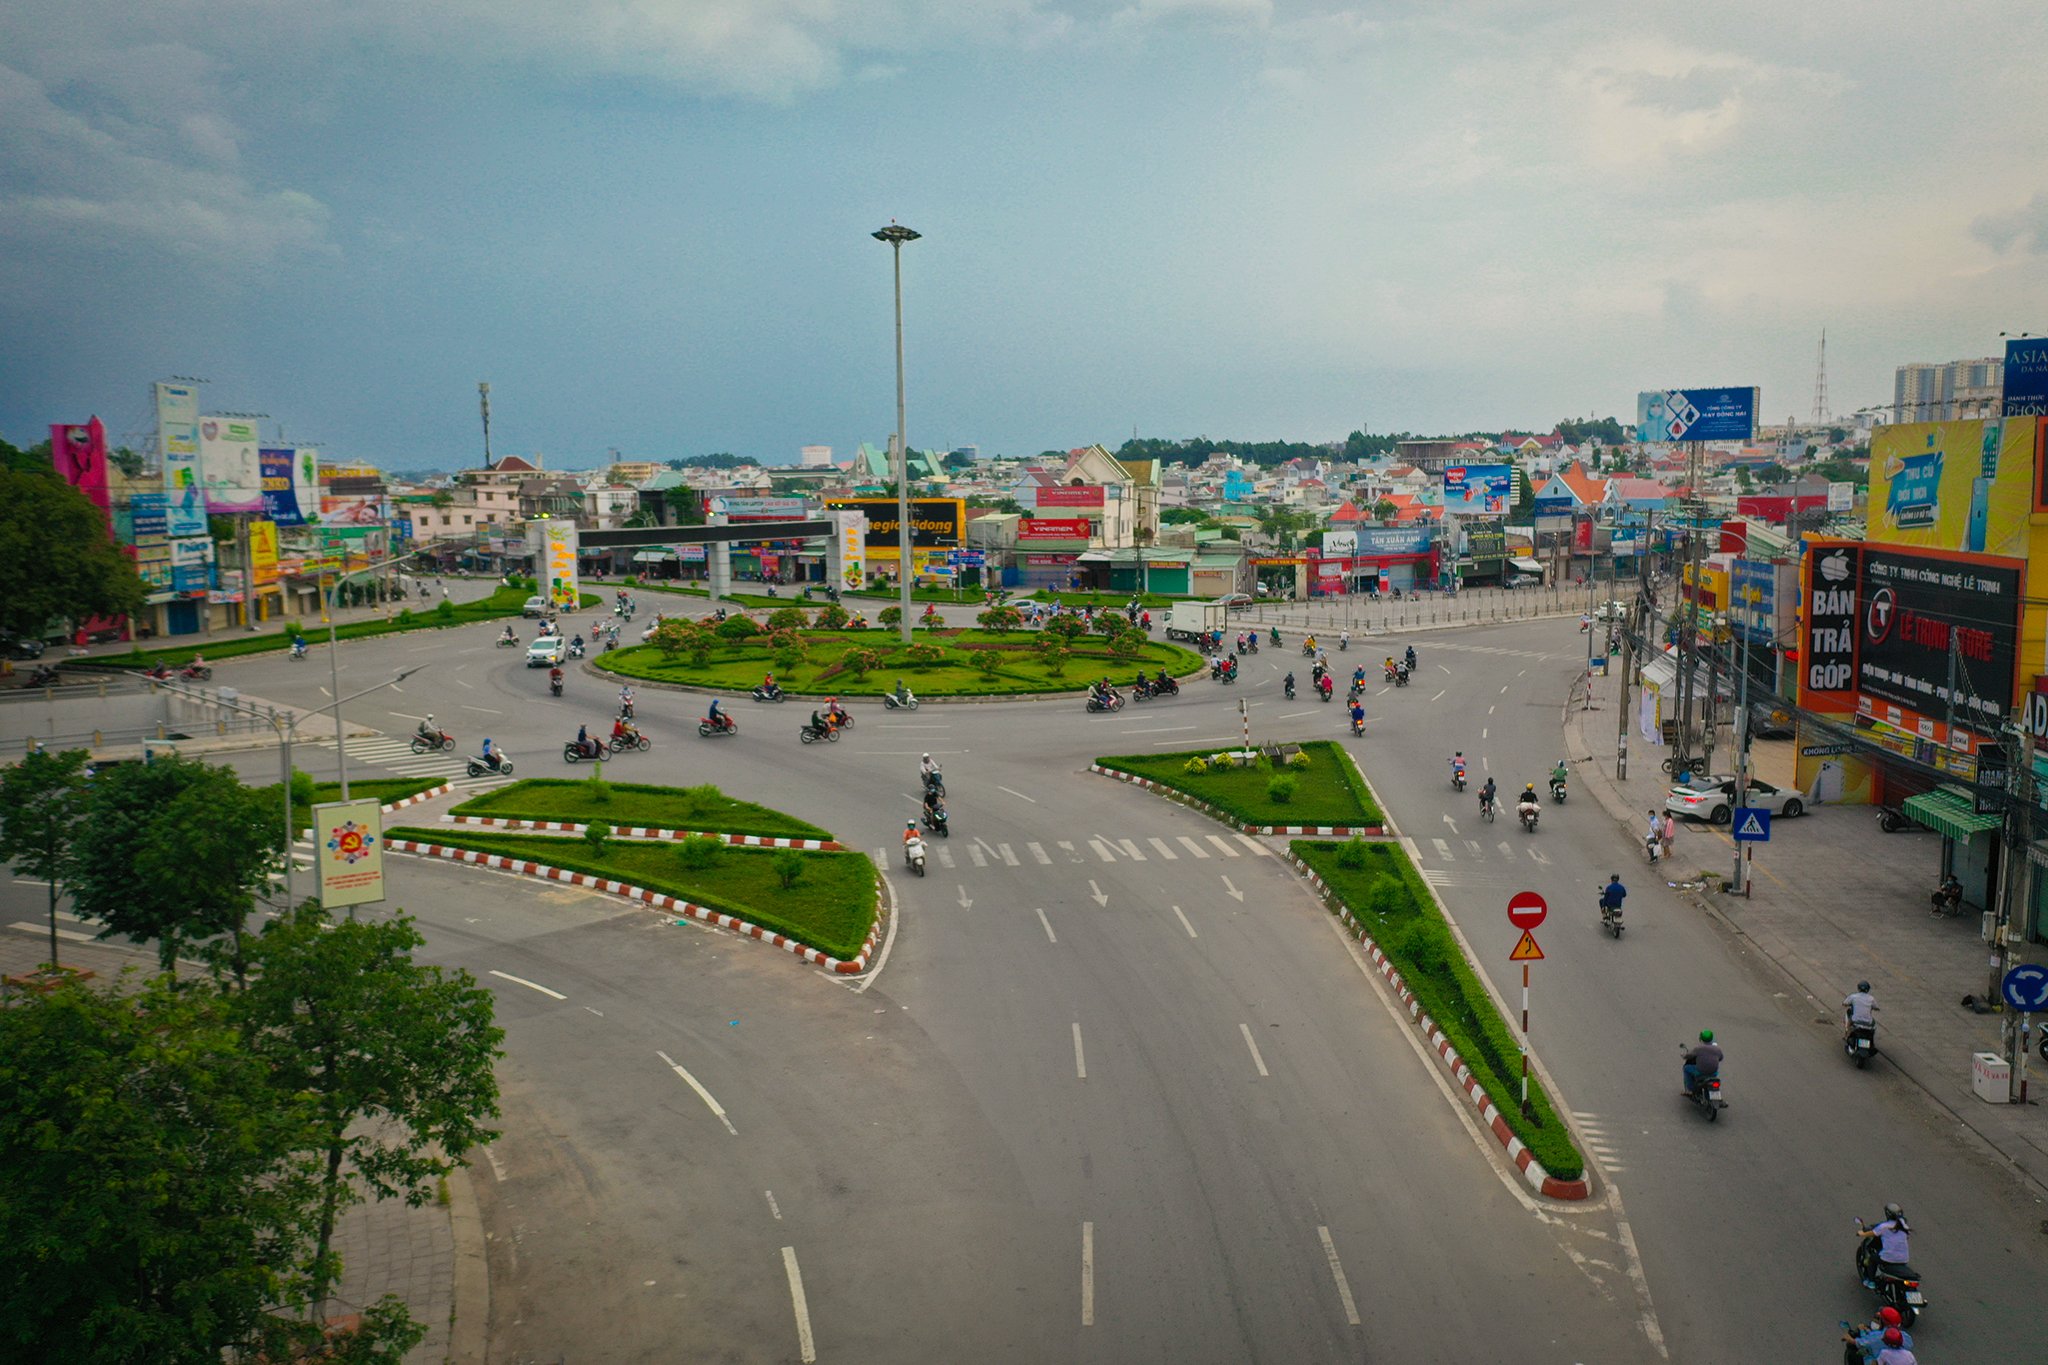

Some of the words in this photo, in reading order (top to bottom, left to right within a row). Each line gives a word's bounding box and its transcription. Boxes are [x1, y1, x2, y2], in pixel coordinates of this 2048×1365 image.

[1905, 467, 1920, 481] THU
[1889, 566, 1899, 577] TY
[1812, 585, 1855, 616] BÁN
[1812, 619, 1852, 653] TRẢ
[1810, 659, 1851, 689] GÓP
